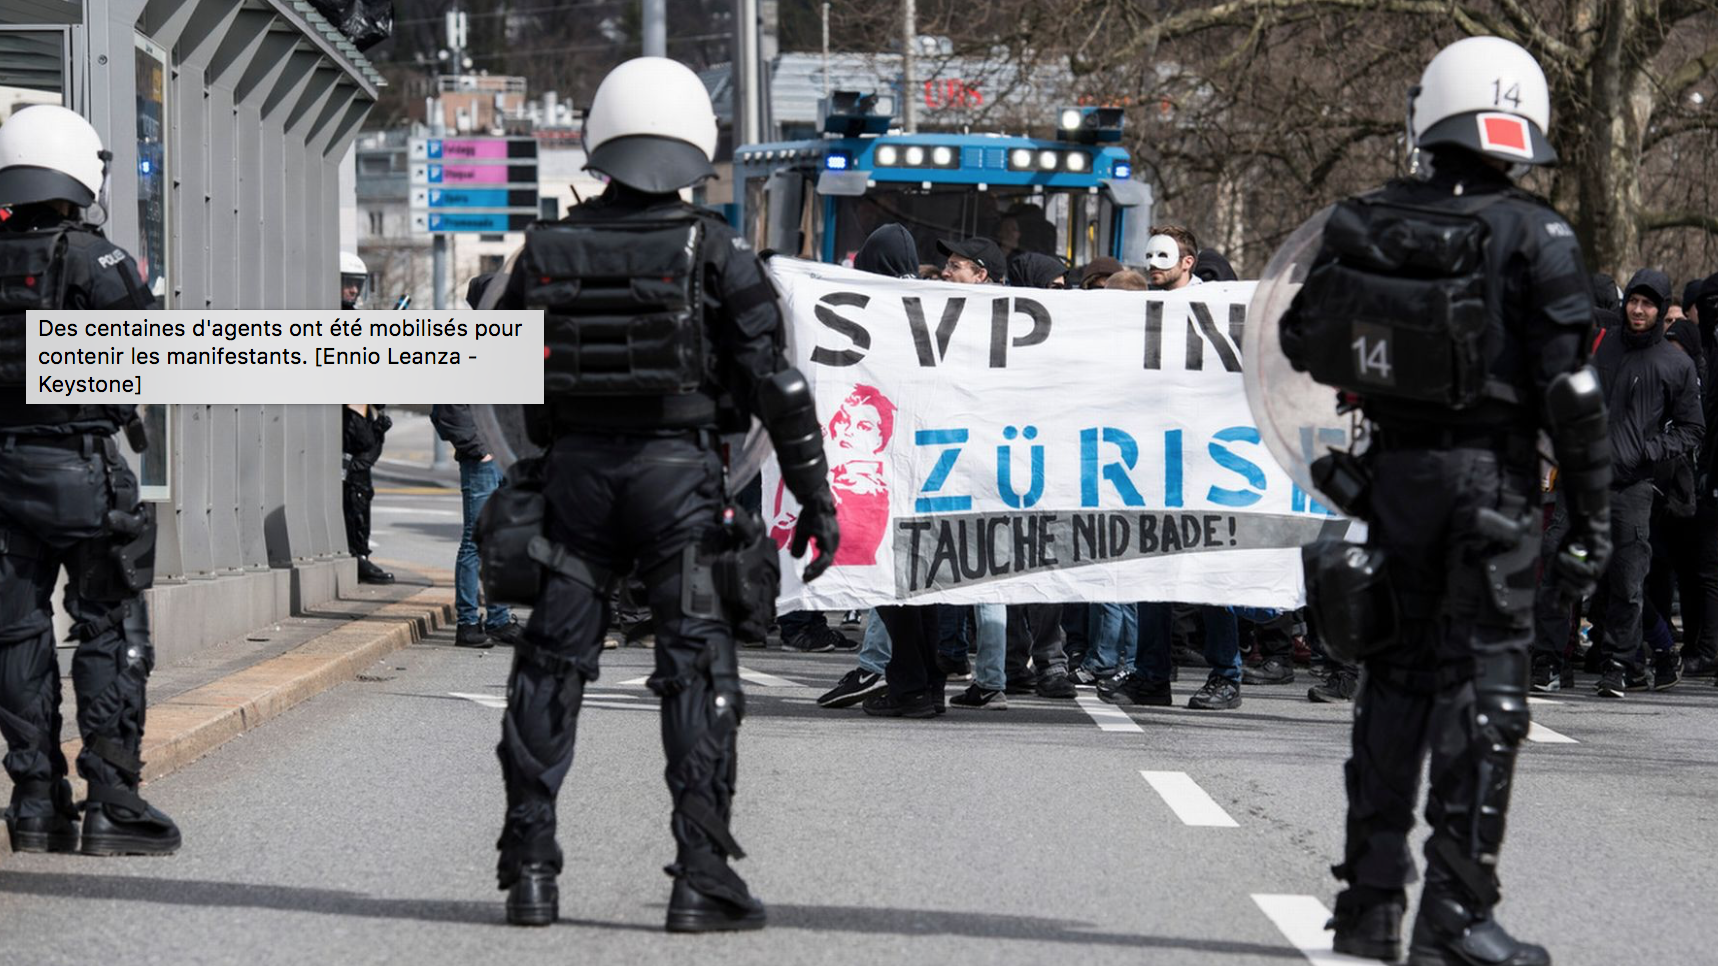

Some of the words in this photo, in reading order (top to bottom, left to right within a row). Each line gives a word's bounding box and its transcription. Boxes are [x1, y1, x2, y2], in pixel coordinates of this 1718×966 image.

[1492, 78, 1522, 108] 14
[810, 291, 1053, 368] SVP
[1143, 300, 1246, 373] IN
[1351, 336, 1391, 378] 14
[900, 514, 1058, 591] TAUCHE
[1072, 513, 1131, 563] NID
[1140, 515, 1237, 553] BADE!
